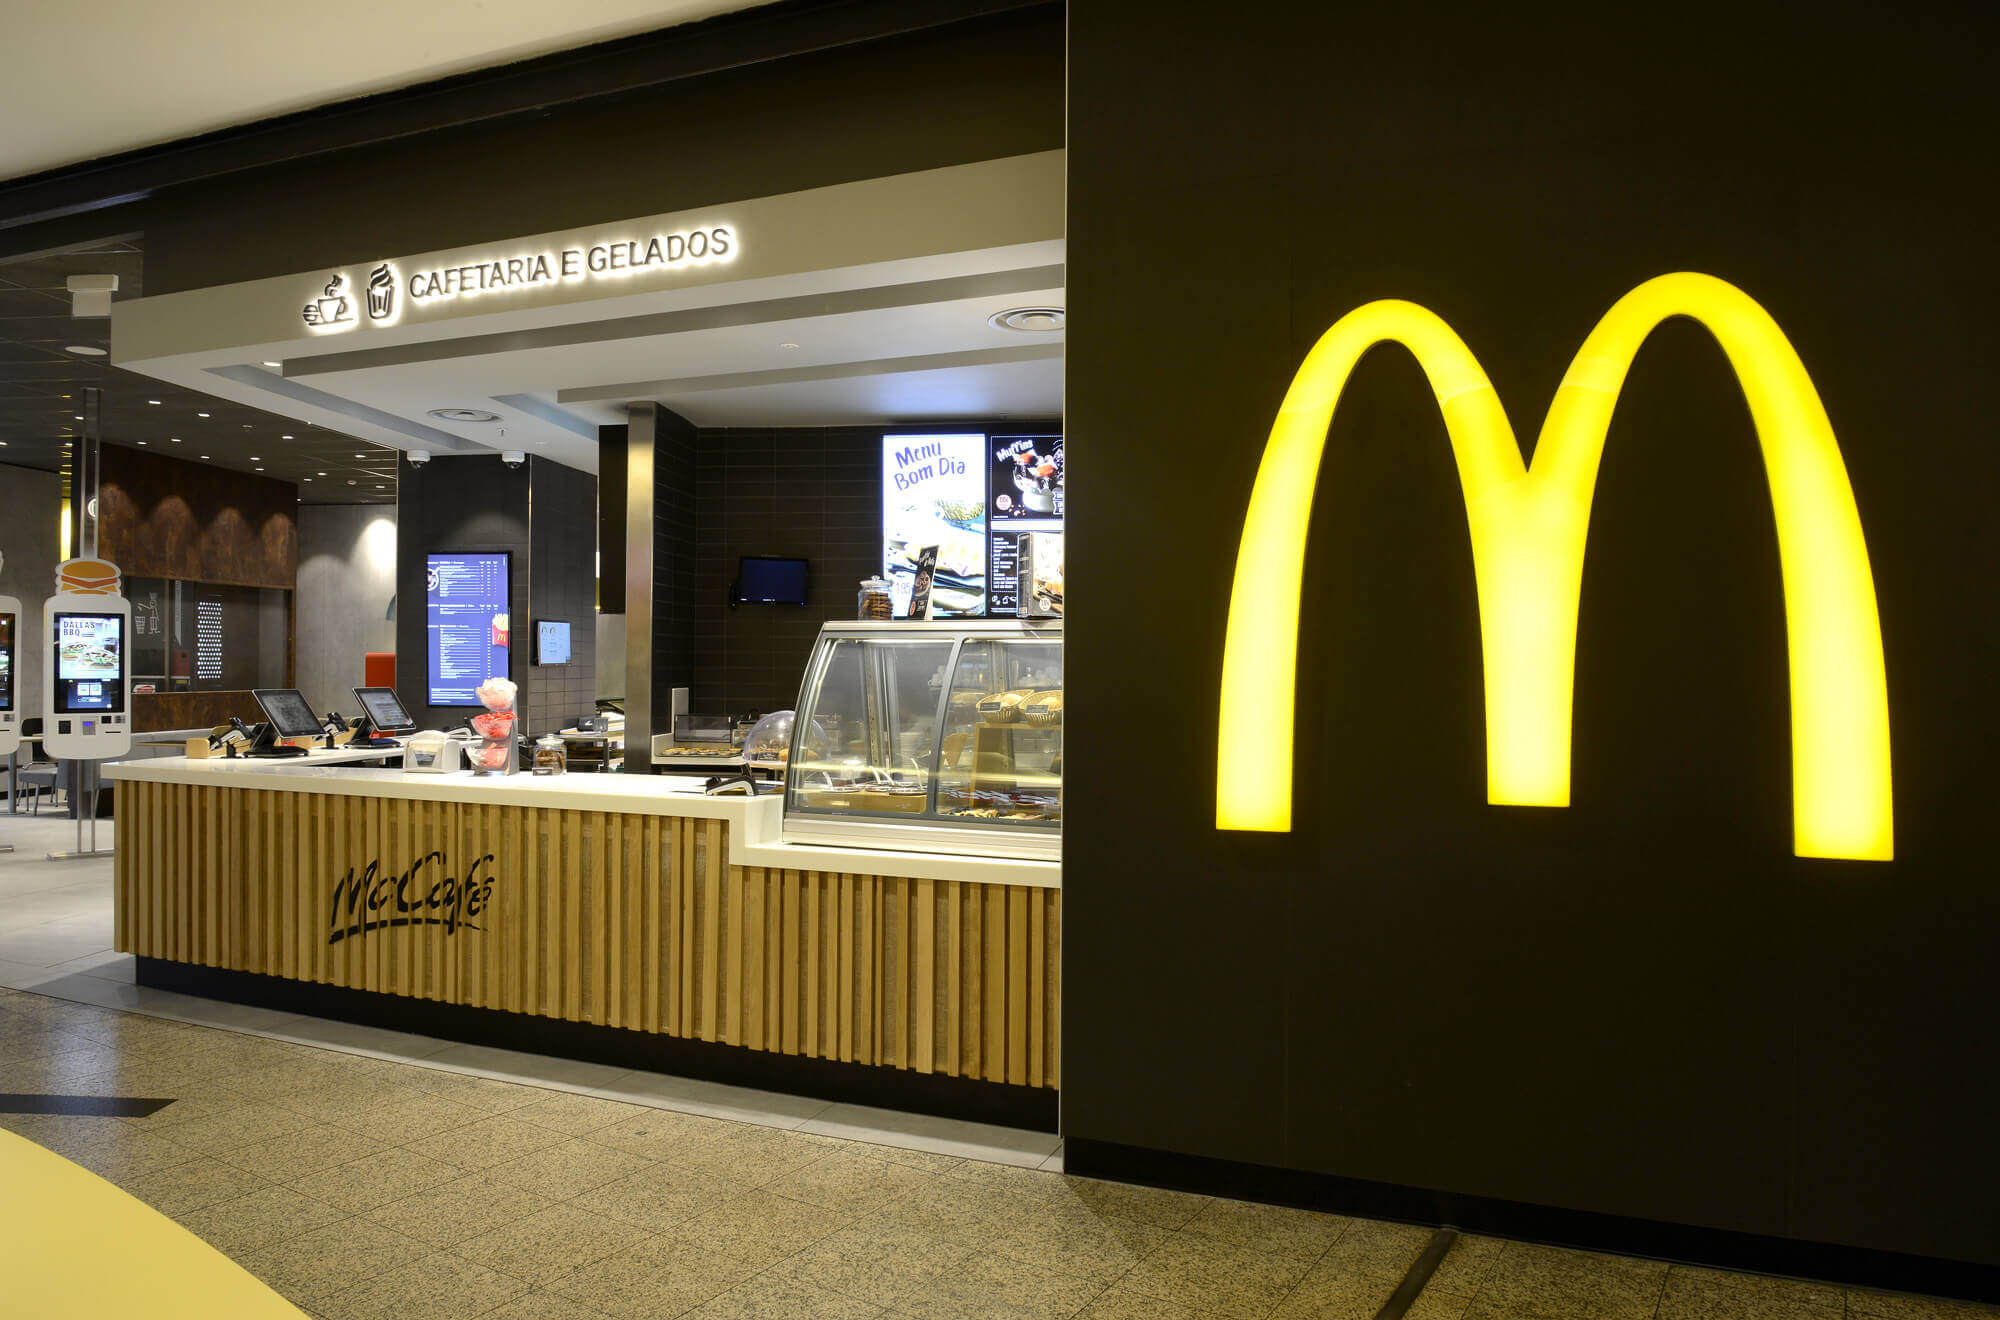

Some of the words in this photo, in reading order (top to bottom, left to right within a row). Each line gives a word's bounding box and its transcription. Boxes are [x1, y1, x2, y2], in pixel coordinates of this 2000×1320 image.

[408, 255, 551, 298] CAFETARIA
[562, 250, 580, 277] E
[587, 228, 730, 272] GELADOS
[895, 441, 942, 469] Menu
[894, 465, 934, 491] Bom
[938, 456, 966, 476] Dia
[63, 621, 96, 629] DALLAS
[330, 851, 495, 940] McCafé
